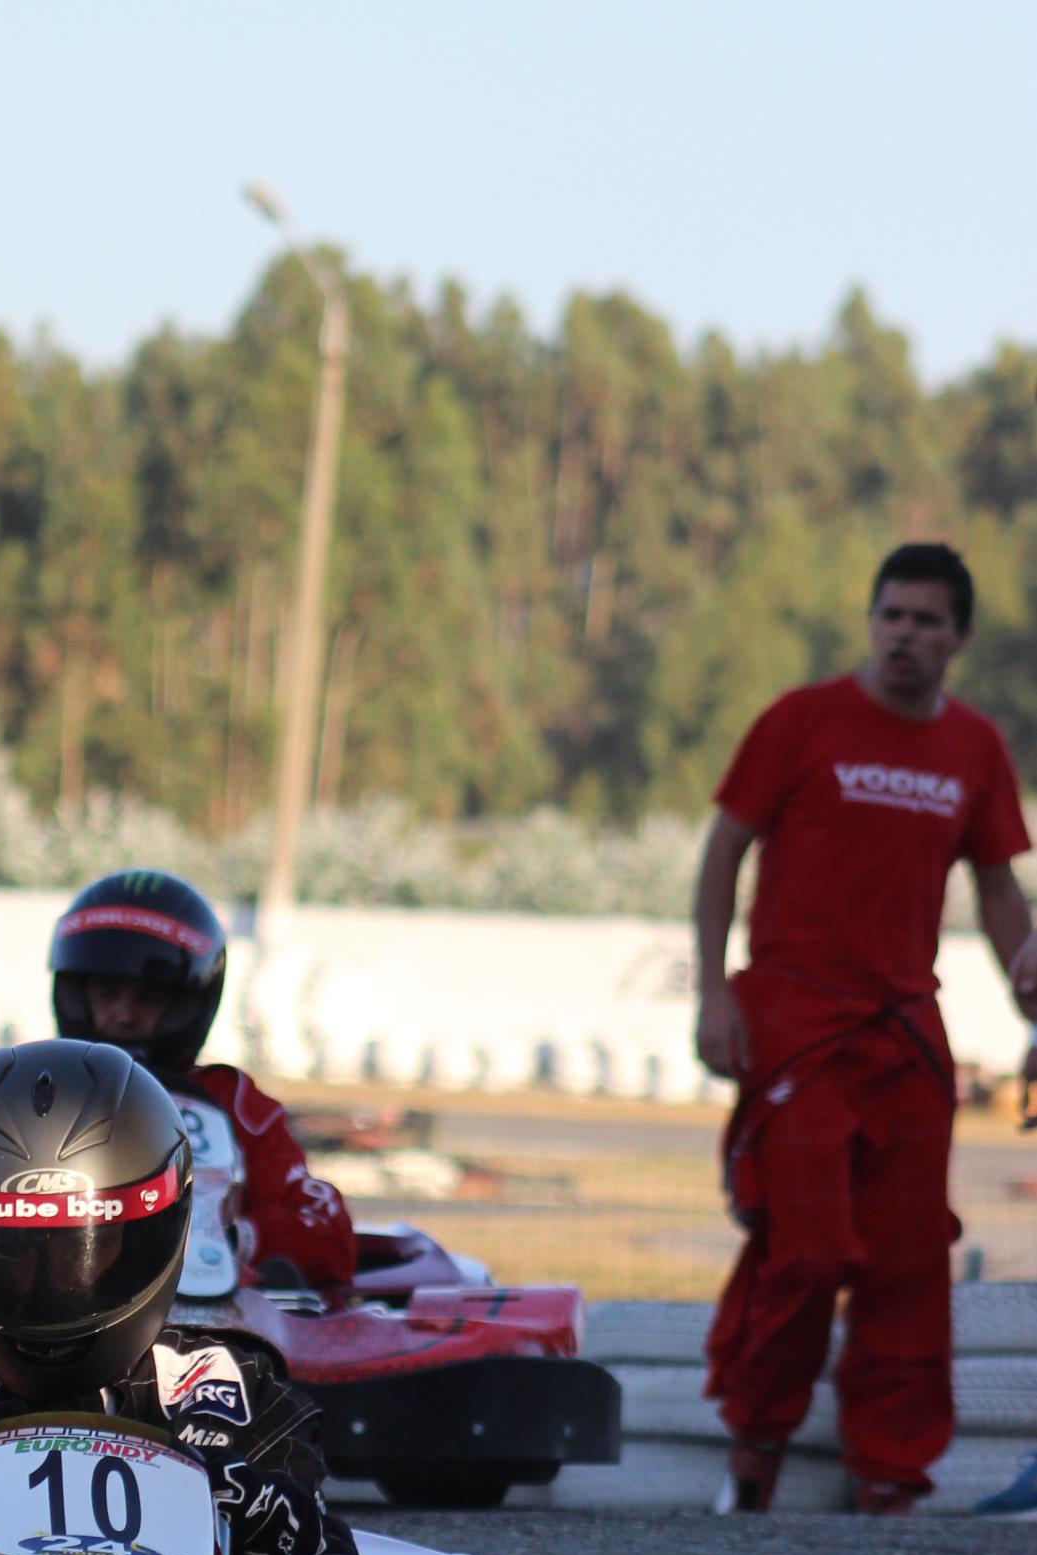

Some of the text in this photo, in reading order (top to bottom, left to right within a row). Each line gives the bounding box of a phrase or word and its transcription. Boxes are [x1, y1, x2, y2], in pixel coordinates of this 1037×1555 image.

[16, 1173, 78, 1195] CMS
[67, 1196, 123, 1221] bcp
[179, 1385, 236, 1412] ERG
[15, 1439, 161, 1462] EUROINDY
[28, 1449, 142, 1542] 10
